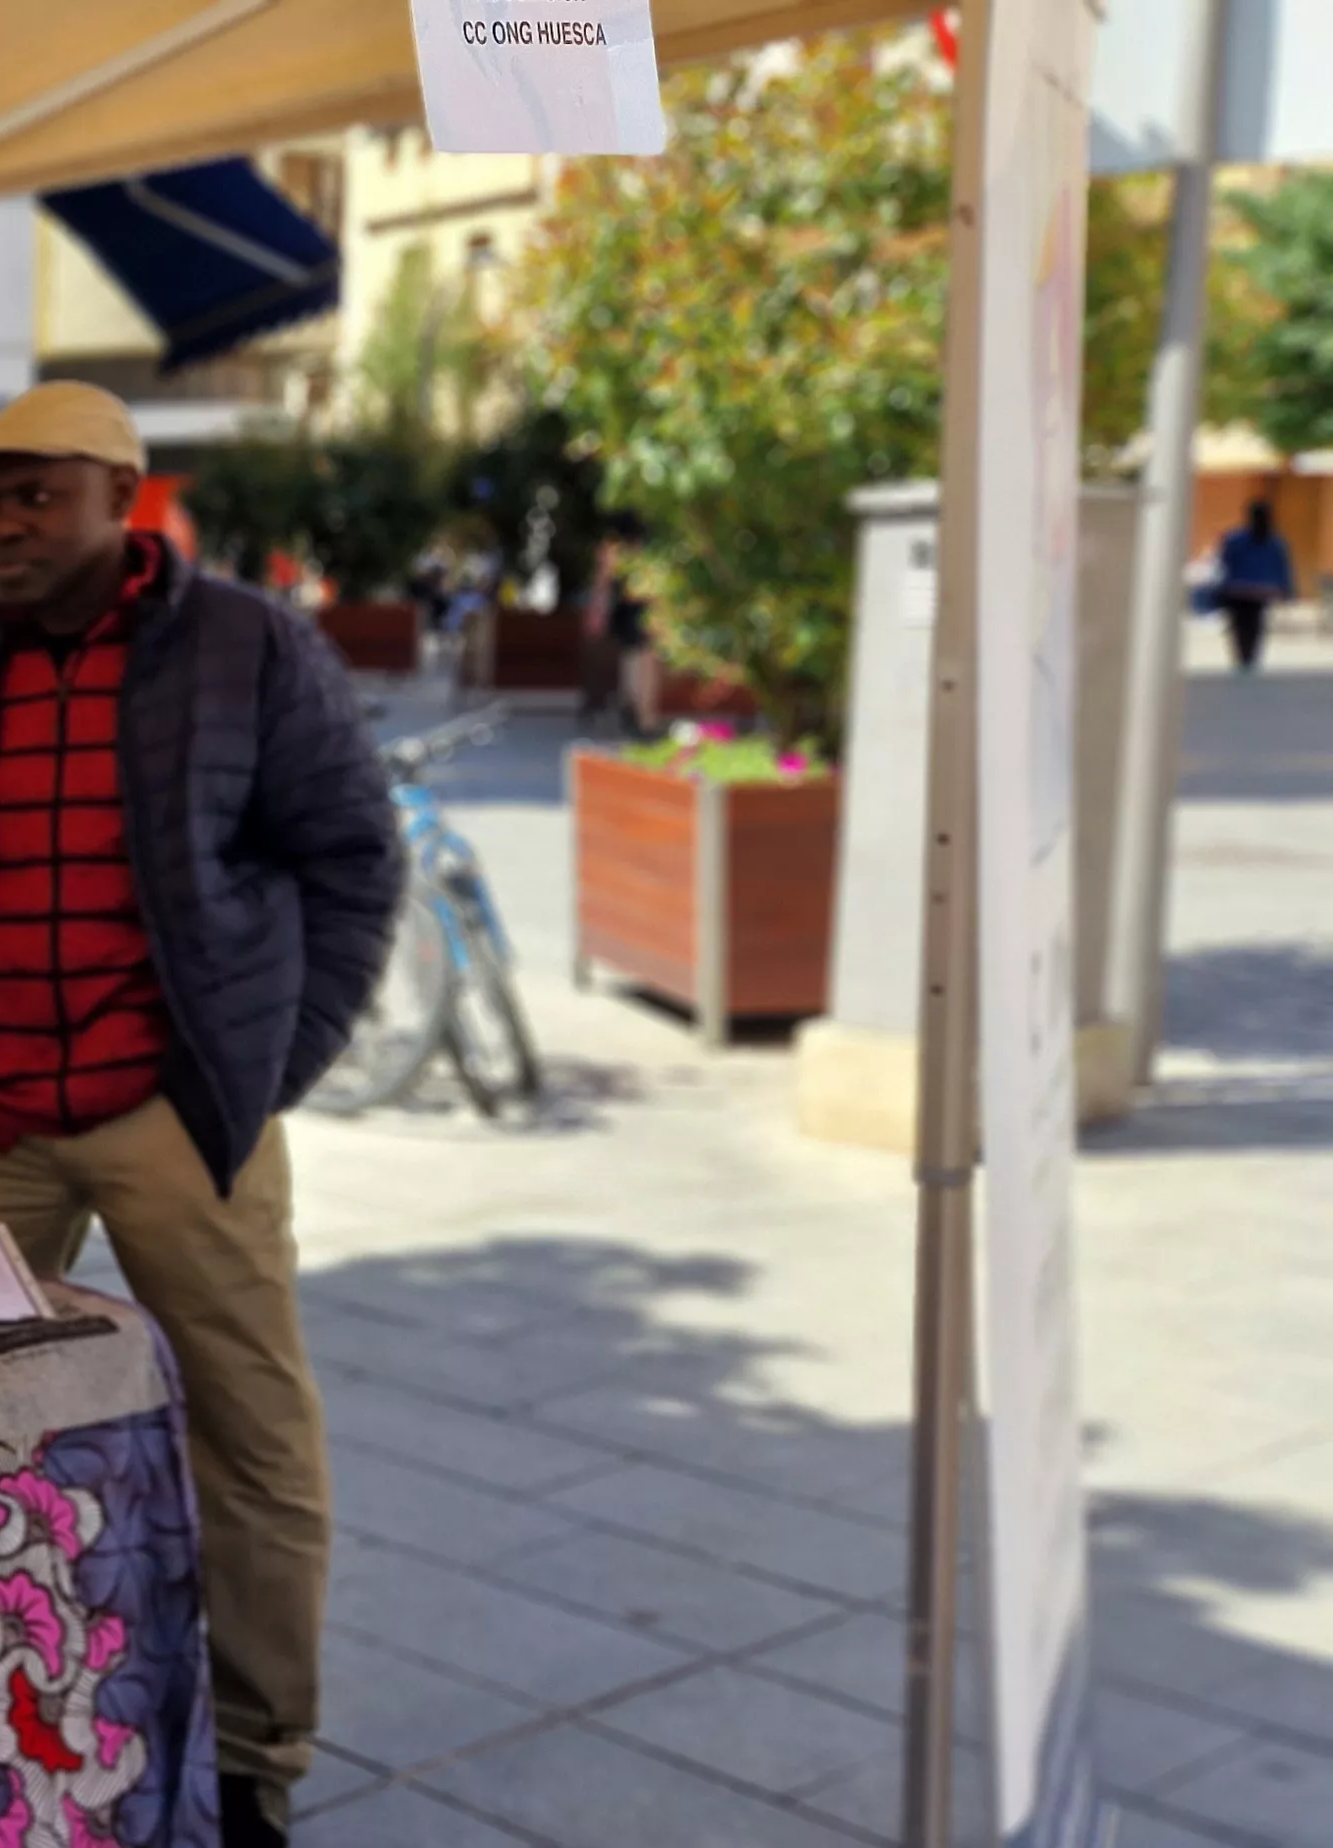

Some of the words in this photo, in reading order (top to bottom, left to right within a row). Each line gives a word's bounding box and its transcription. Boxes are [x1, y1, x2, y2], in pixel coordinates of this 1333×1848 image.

[462, 21, 487, 45] CC
[492, 21, 533, 45] ONG
[537, 21, 607, 46] HUESCA
